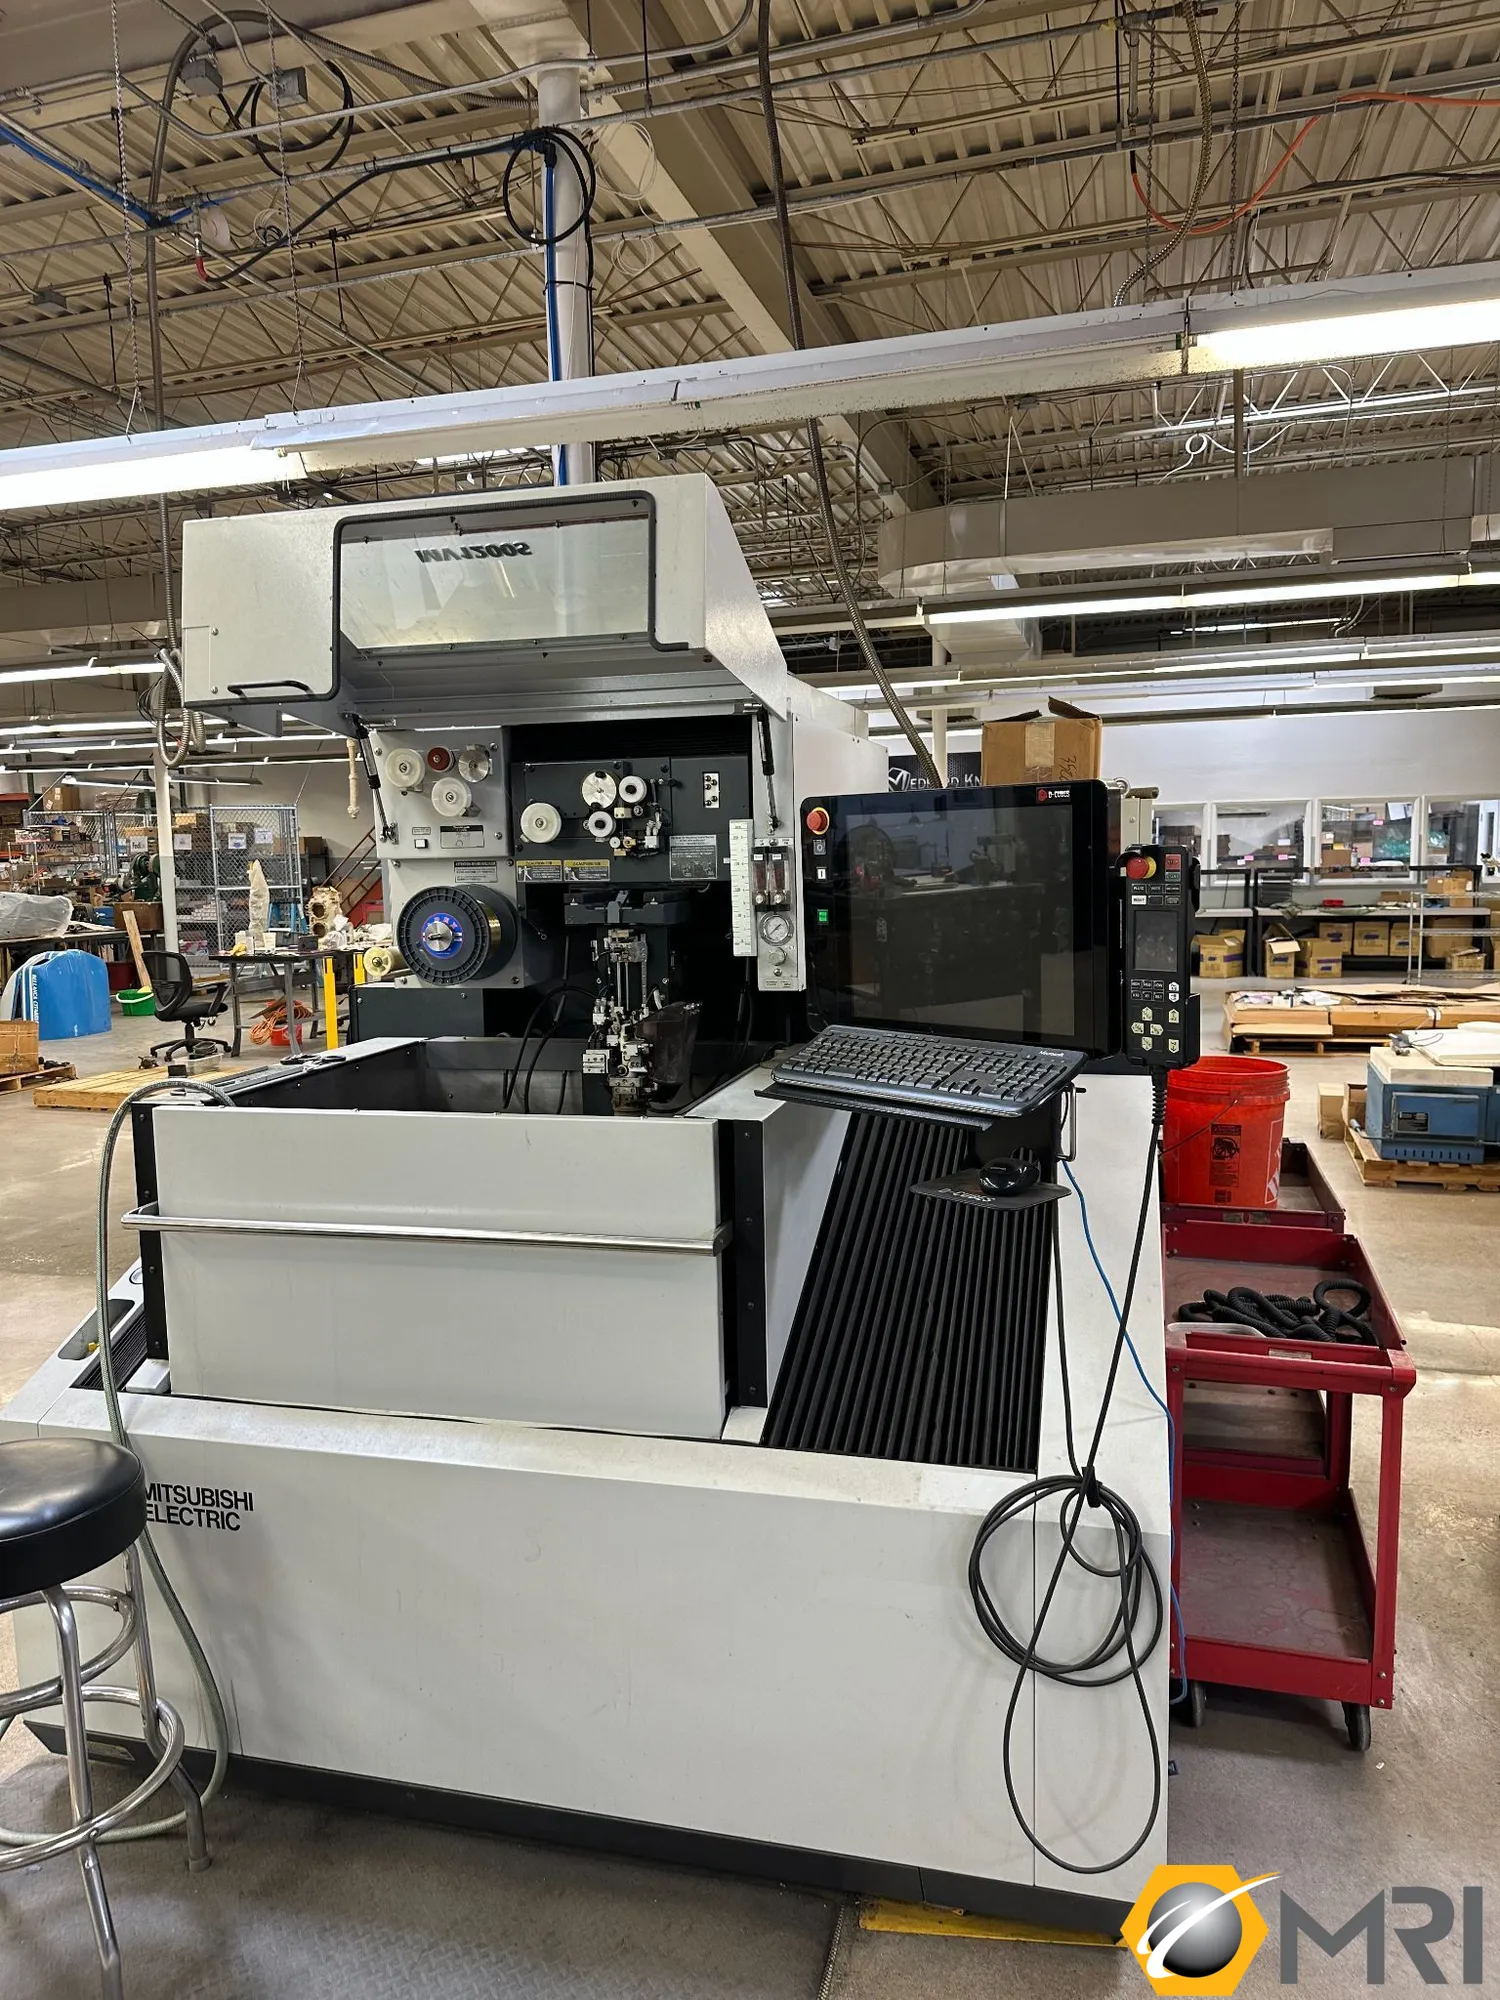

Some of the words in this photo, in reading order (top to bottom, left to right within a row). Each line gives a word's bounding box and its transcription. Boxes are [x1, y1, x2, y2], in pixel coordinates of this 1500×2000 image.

[1048, 790, 1070, 798] D-CUBES
[146, 1483, 254, 1511] MITSUBISHI
[146, 1503, 241, 1531] ELECTRIC
